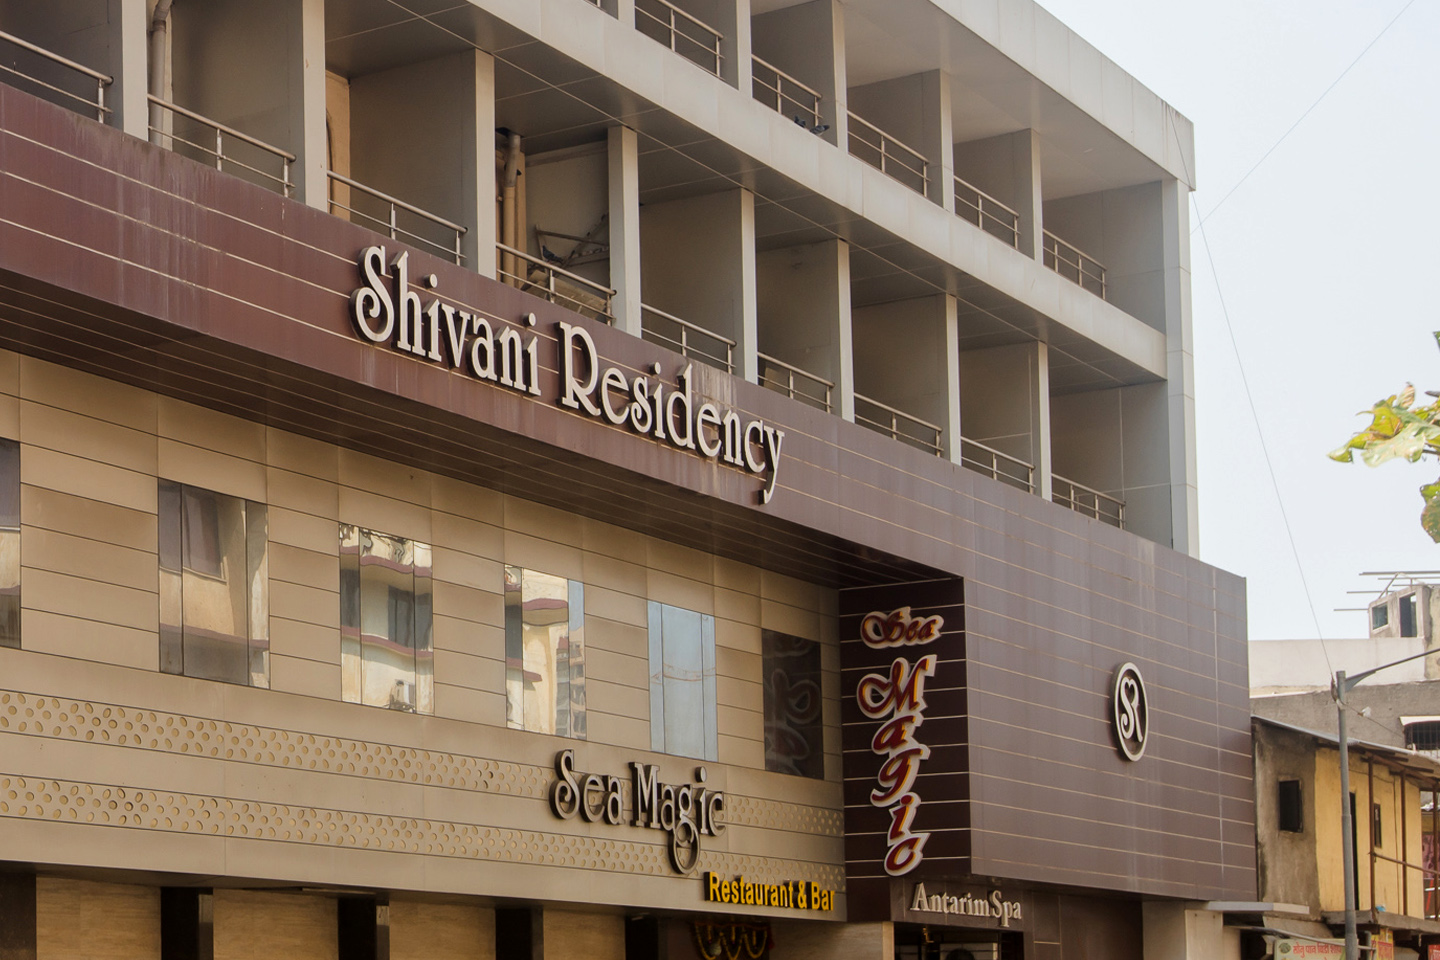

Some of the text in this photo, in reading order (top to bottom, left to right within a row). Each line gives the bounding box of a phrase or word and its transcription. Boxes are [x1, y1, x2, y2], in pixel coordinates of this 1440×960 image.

[350, 245, 785, 505] Shivani Residency
[861, 607, 944, 649] Sea
[549, 749, 726, 875] Sea Magic
[857, 654, 938, 876] Magic
[706, 871, 835, 911] Restaurant & Bar
